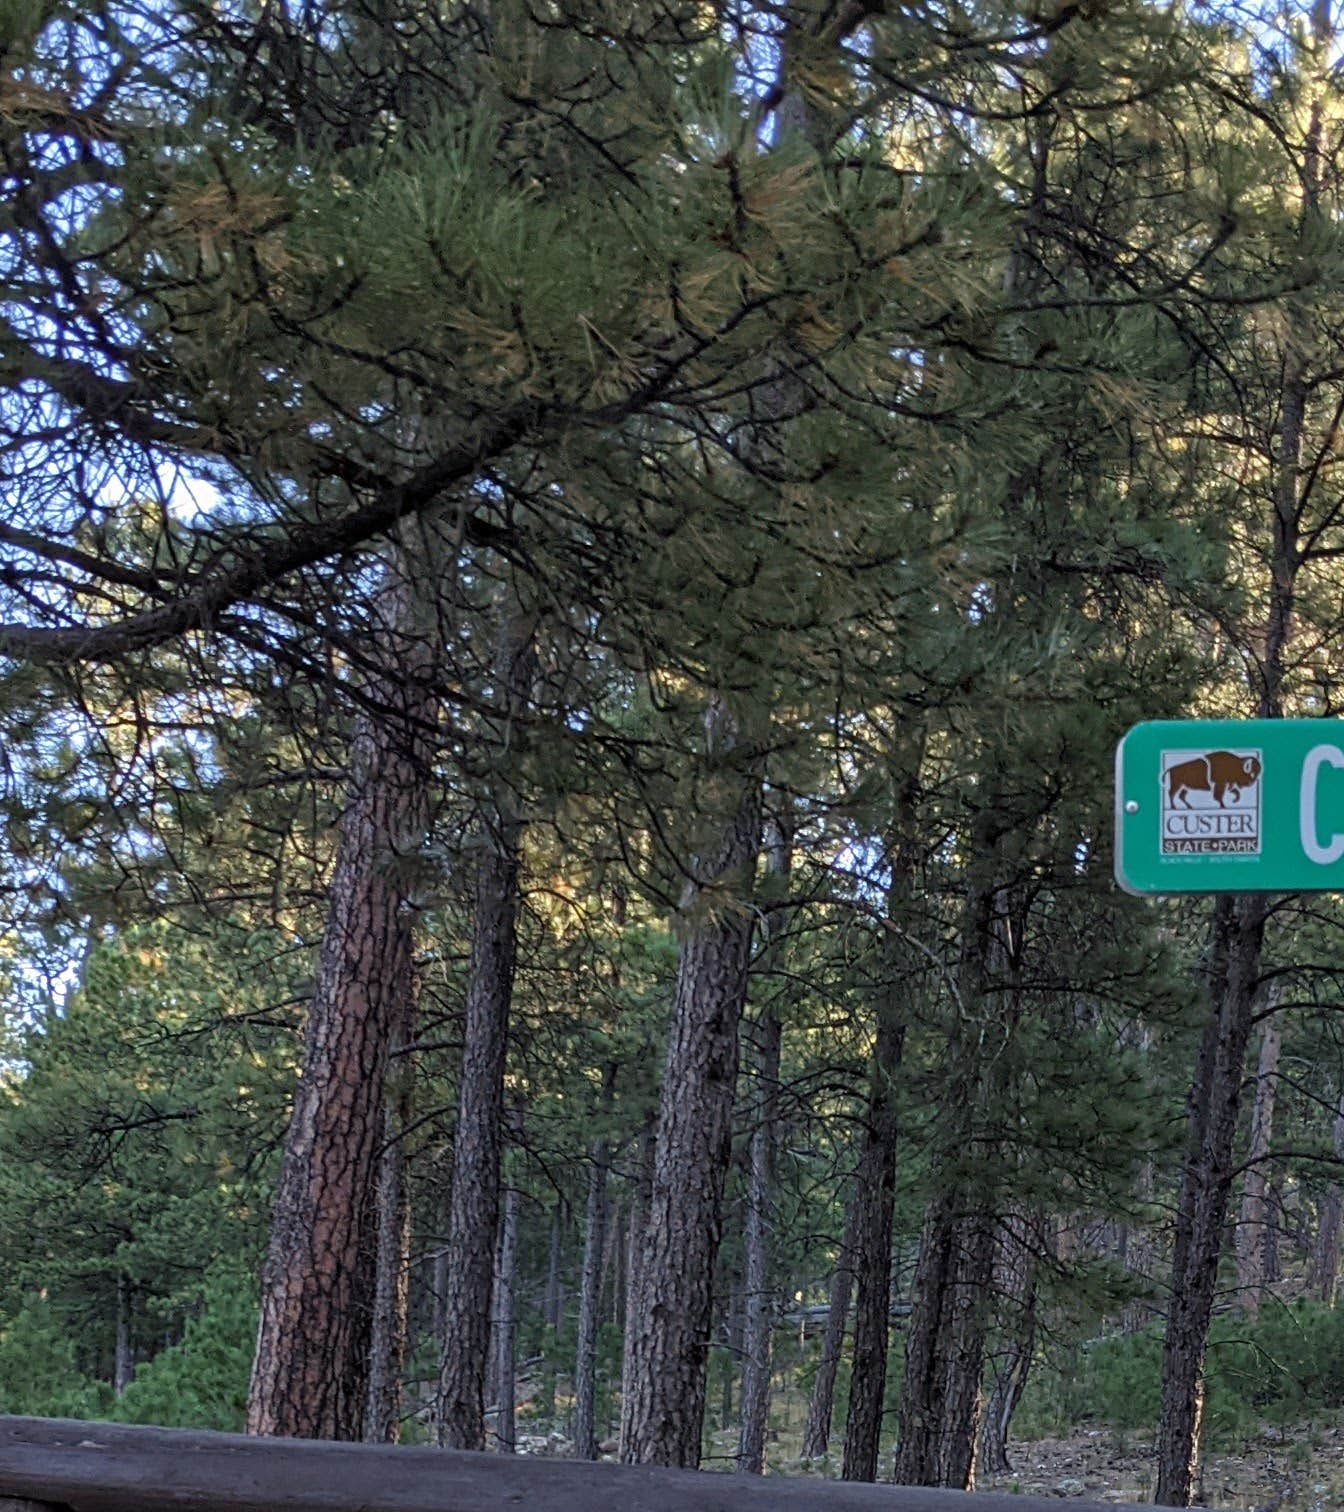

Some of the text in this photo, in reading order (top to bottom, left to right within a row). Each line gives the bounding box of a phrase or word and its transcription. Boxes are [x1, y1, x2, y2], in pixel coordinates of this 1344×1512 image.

[1167, 814, 1254, 834] CUSTER
[1165, 840, 1257, 852] STATE PARK
